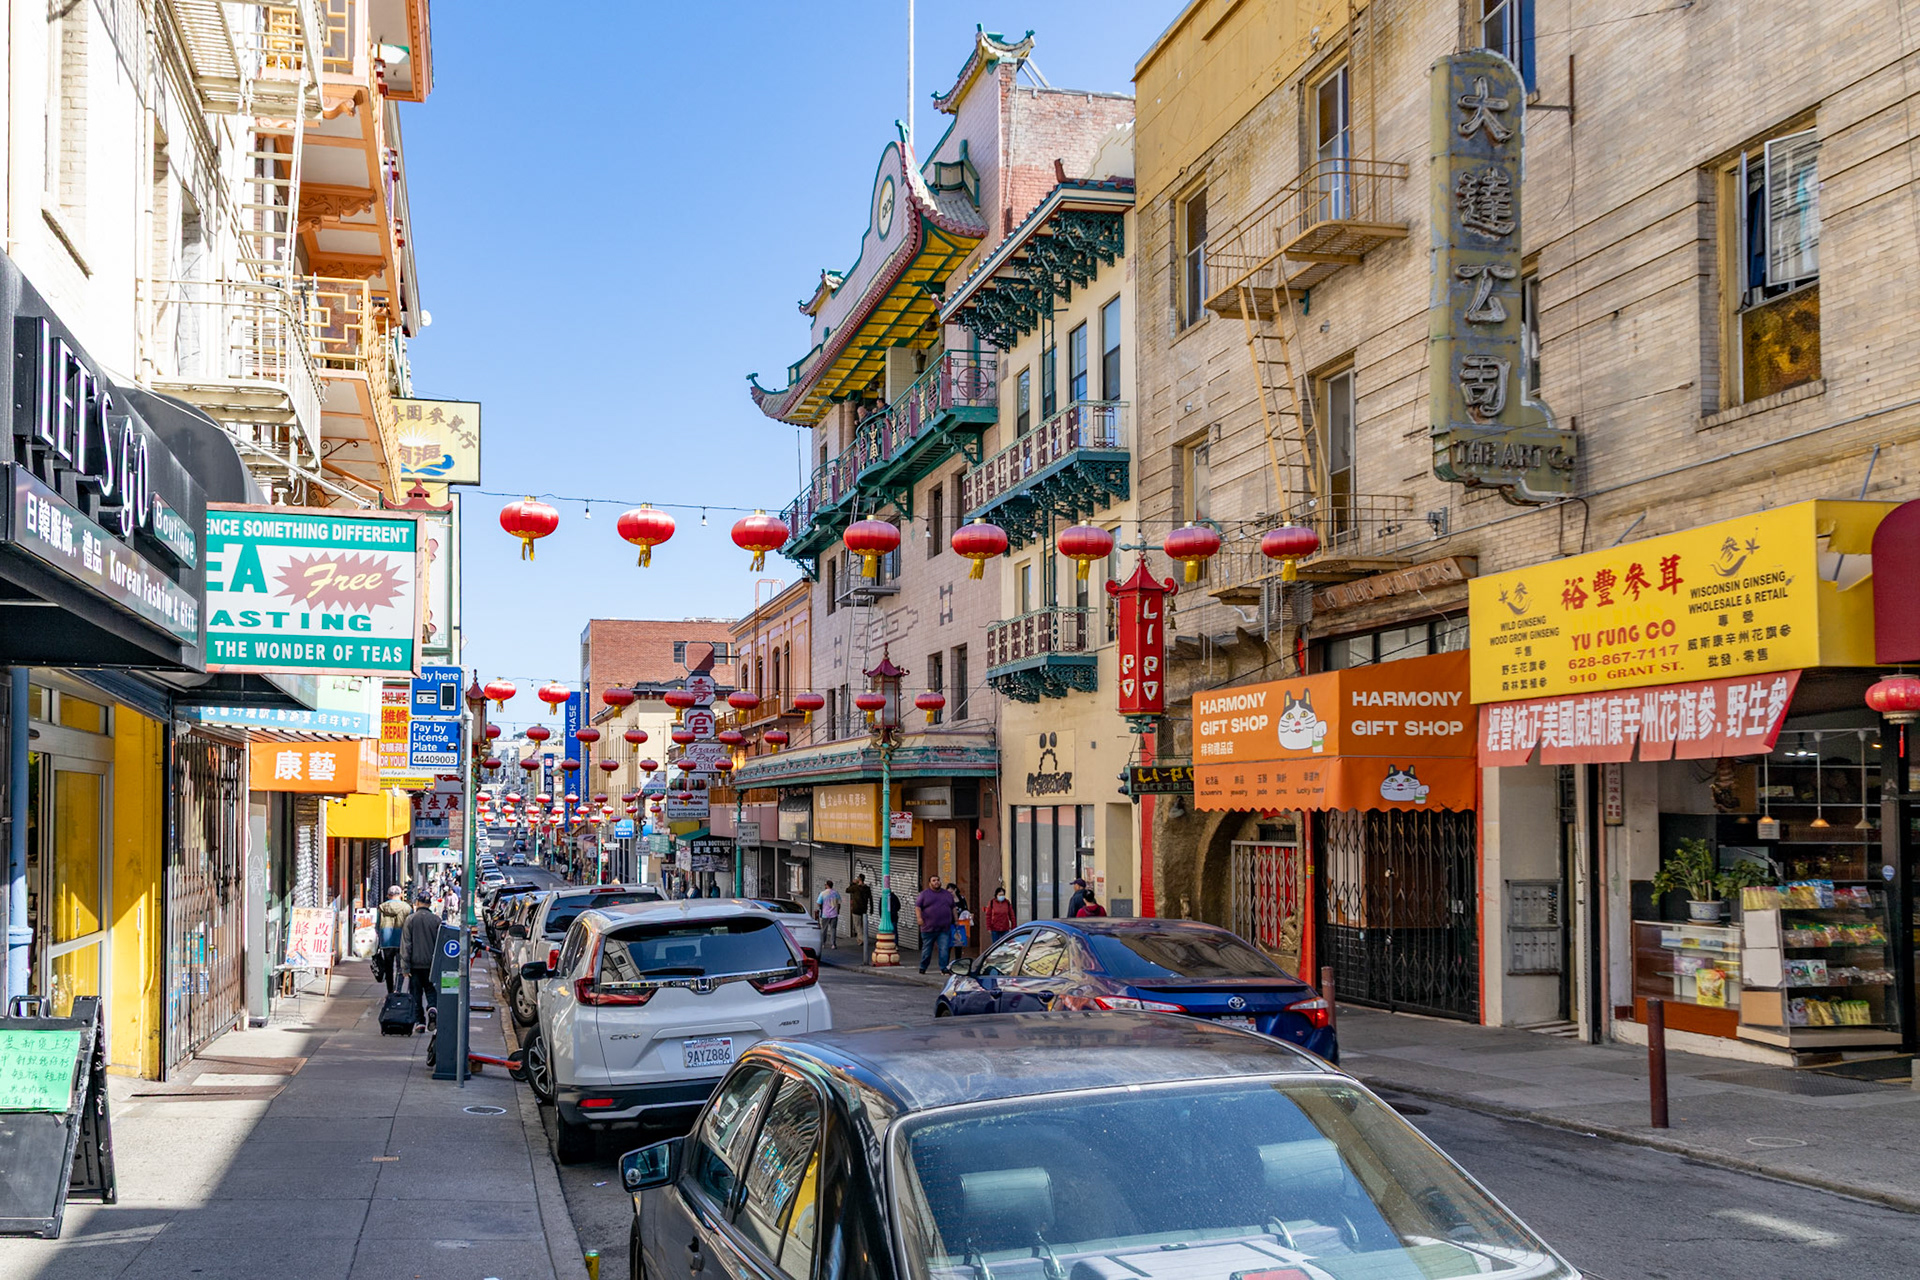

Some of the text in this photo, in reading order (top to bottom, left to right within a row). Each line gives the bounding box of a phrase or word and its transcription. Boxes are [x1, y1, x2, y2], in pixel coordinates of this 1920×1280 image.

[42, 317, 114, 496] LET'S
[1454, 440, 1496, 464] THE
[1501, 442, 1541, 468] ART
[155, 500, 195, 561] Boutique
[243, 521, 329, 539] SOMETHING
[332, 526, 409, 543] DIFFERENT
[110, 549, 142, 598] Korean
[143, 577, 172, 617] Fashion
[180, 601, 195, 633] Gift
[303, 563, 383, 599] Free
[1690, 570, 1786, 599] WISCONSIN GINSENG
[1688, 586, 1789, 614] WHOLESALE & RETAIL
[209, 609, 372, 632] ASTING
[1501, 615, 1547, 632] WILD GINSENG
[1490, 627, 1560, 646] WOOD GROW GINSENG
[1571, 619, 1676, 652] YU FUNG CO
[215, 641, 402, 663] THE WONDER OF TEAS
[1568, 644, 1680, 670] 628-867-7117
[421, 671, 459, 682] ay here
[1569, 661, 1685, 684] 910 GRANT ST.
[1200, 691, 1267, 715] HARMONY
[1352, 692, 1462, 706] HARMONY
[413, 723, 446, 734] Pay by
[569, 705, 577, 738] CHASE
[1200, 715, 1268, 736] GIFT SHOP
[1351, 720, 1463, 736] GIFT SHOP
[413, 733, 448, 742] License
[413, 743, 437, 751] Plate
[414, 755, 456, 764] 44409003
[689, 744, 723, 755] Grand
[274, 750, 336, 781] 康藝
[294, 921, 330, 937] 修改
[293, 938, 328, 953] 衣服
[610, 1033, 642, 1041] CR-V
[687, 1047, 730, 1064] 9AYZ886
